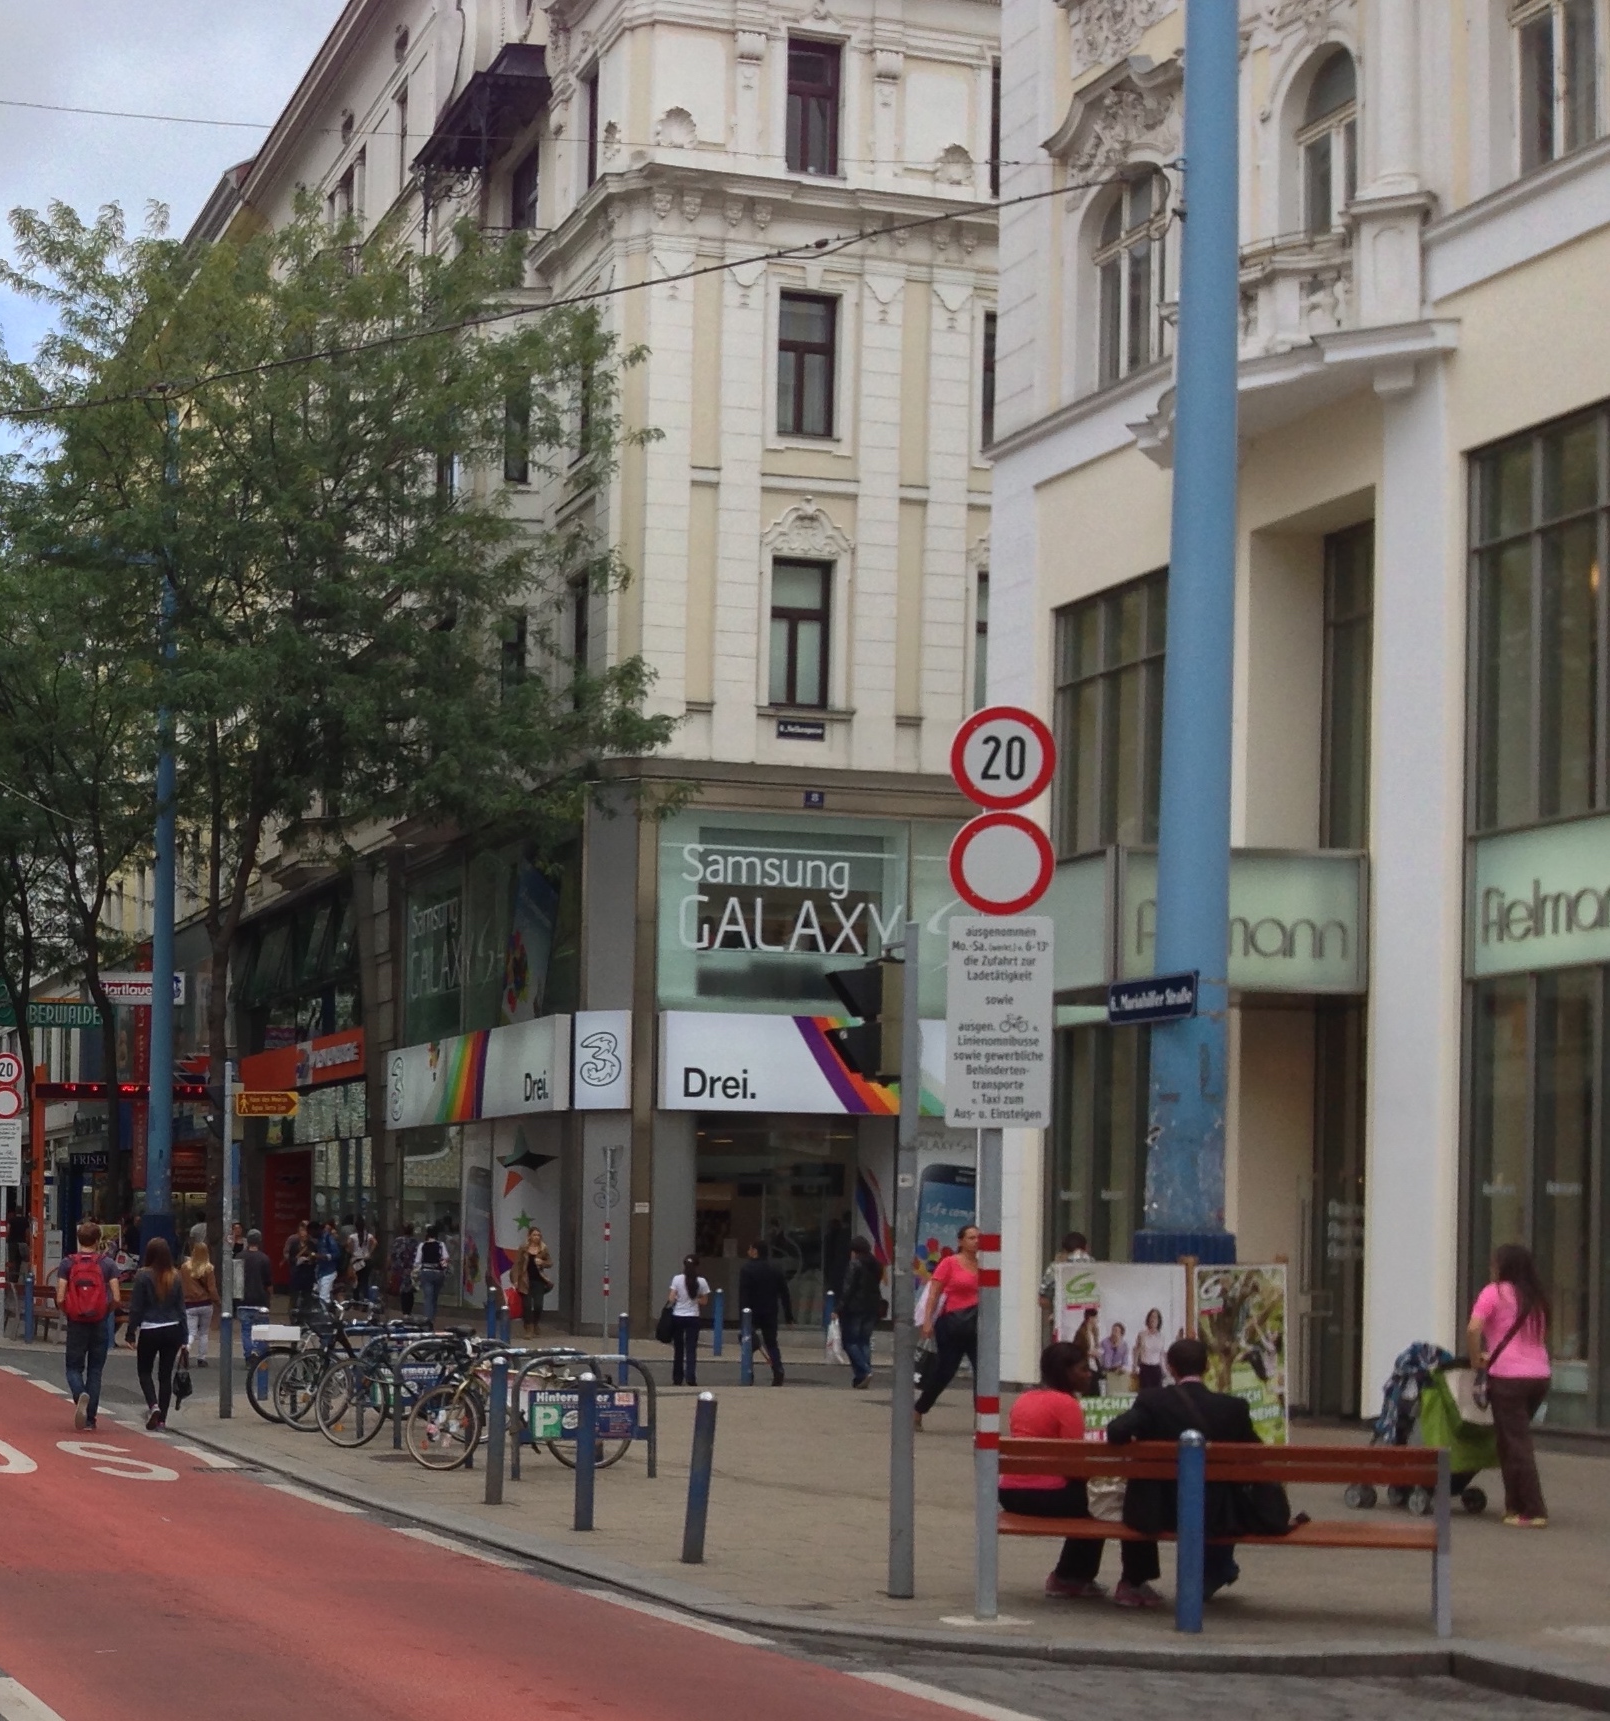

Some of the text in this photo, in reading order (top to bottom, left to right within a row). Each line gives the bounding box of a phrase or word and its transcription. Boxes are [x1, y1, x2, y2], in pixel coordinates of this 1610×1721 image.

[981, 735, 1027, 781] 20
[682, 843, 851, 900] Samsung
[679, 895, 903, 956] GALAXY
[966, 927, 1036, 939] ausgenommen
[964, 955, 1036, 967] die Zufahrt zur
[967, 970, 1032, 983] Ladetätigkeit
[101, 981, 153, 996] Hartlaue
[985, 994, 1014, 1005] sowie
[26, 1004, 104, 1025] BERWALDE
[958, 1035, 1039, 1047] Linienomnibusse
[580, 1031, 621, 1087] 3
[953, 1050, 1044, 1063] sowie gewerbliche
[0, 1062, 13, 1077] 20
[966, 1064, 1029, 1075] Behinderten-
[523, 1070, 549, 1103] Drei.
[683, 1066, 758, 1100] Drei.
[972, 1081, 1024, 1091] transporte
[982, 1093, 1001, 1104] Taxi
[1004, 1096, 1024, 1104] zum
[954, 1108, 975, 1119] Aus-
[991, 1108, 1042, 1121] Einsteigen
[535, 1405, 559, 1437] P
